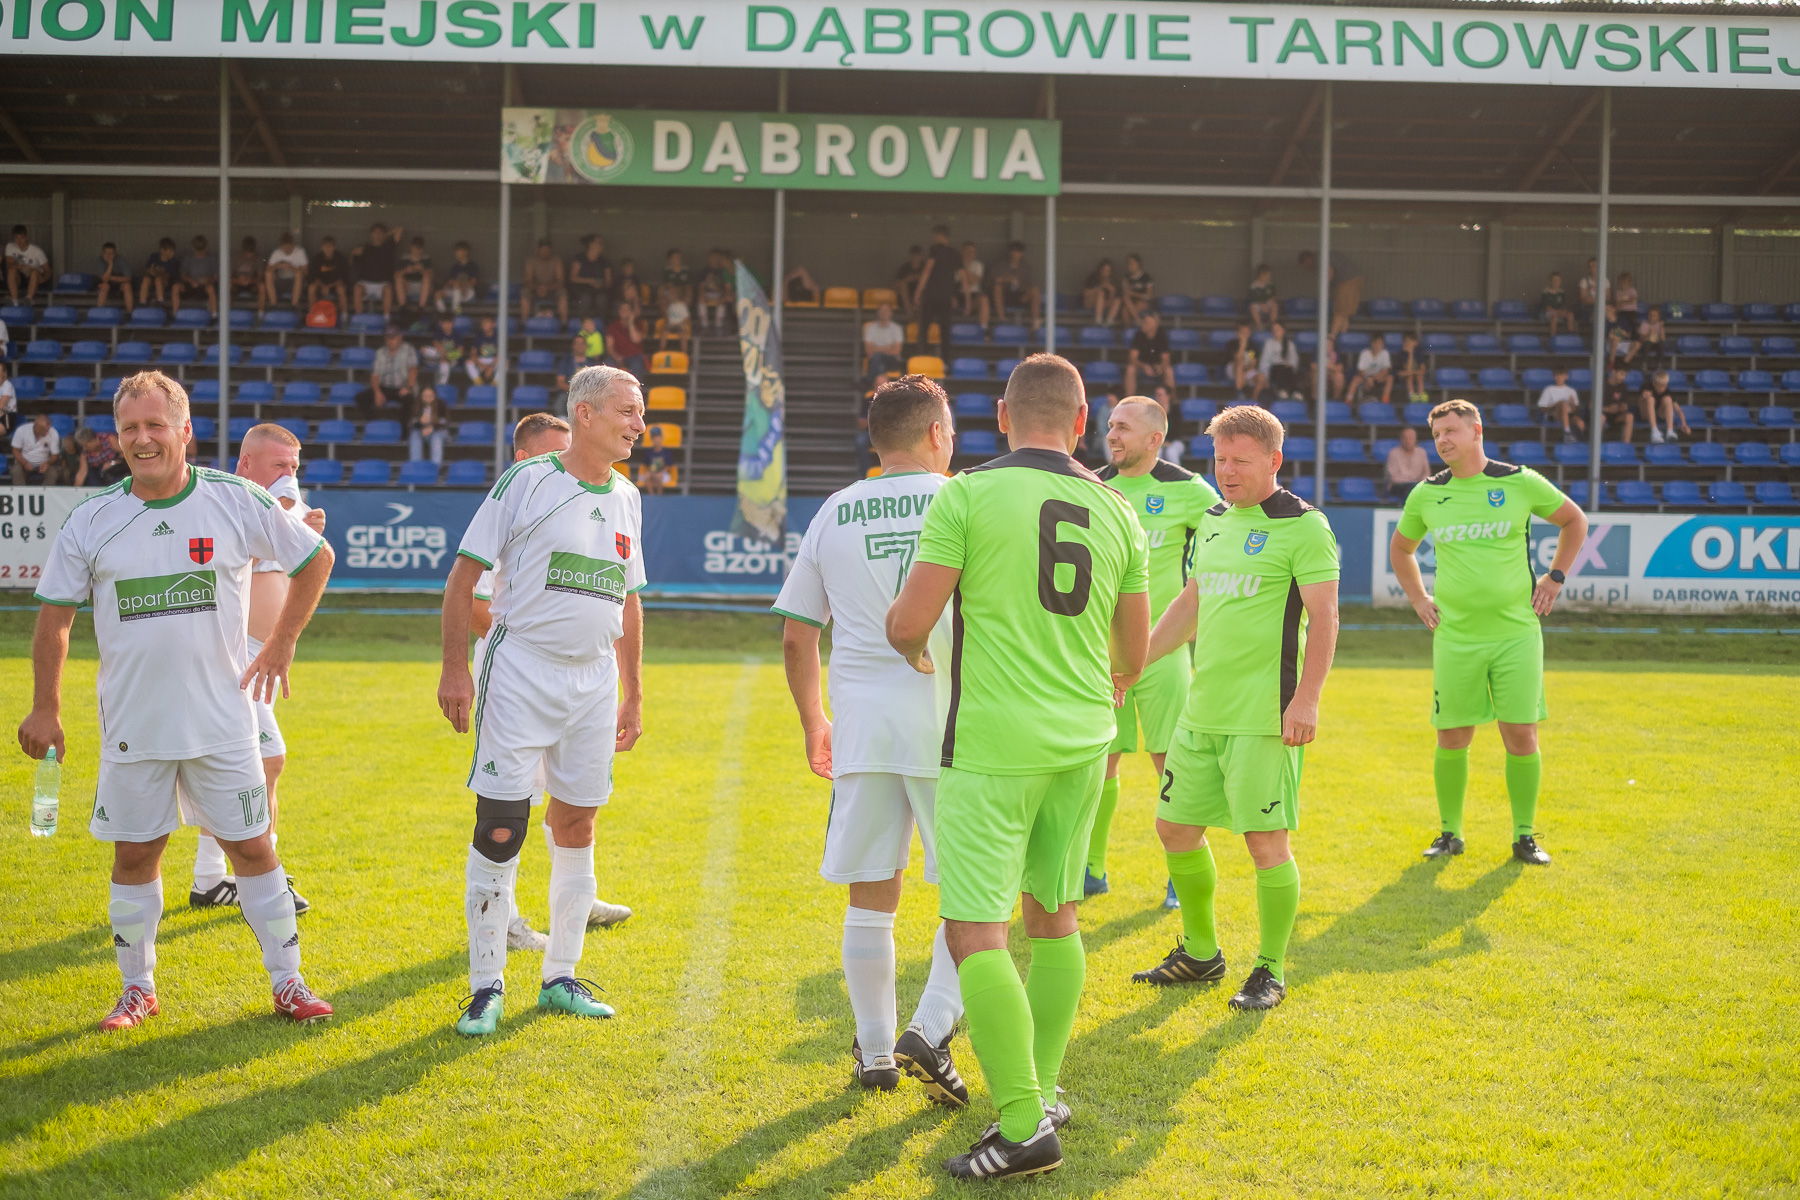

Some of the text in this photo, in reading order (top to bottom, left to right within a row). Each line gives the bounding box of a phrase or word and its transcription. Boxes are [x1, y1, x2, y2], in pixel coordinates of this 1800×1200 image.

[0, 0, 175, 42] ION
[220, 0, 596, 49] MIEJSKI
[641, 14, 706, 51] w
[746, 4, 1192, 67] DĄBROWIE
[652, 118, 1046, 183] DĄBROVIA
[0, 494, 45, 517] BIU
[152, 528, 175, 537] adidas
[864, 530, 922, 601] 7
[1037, 498, 1093, 618] 6
[548, 567, 626, 595] apartmen
[1557, 582, 1630, 607] ud.pl
[1652, 588, 1740, 605] DĄBROWA
[1160, 768, 1175, 803] 2
[238, 783, 267, 827] 17
